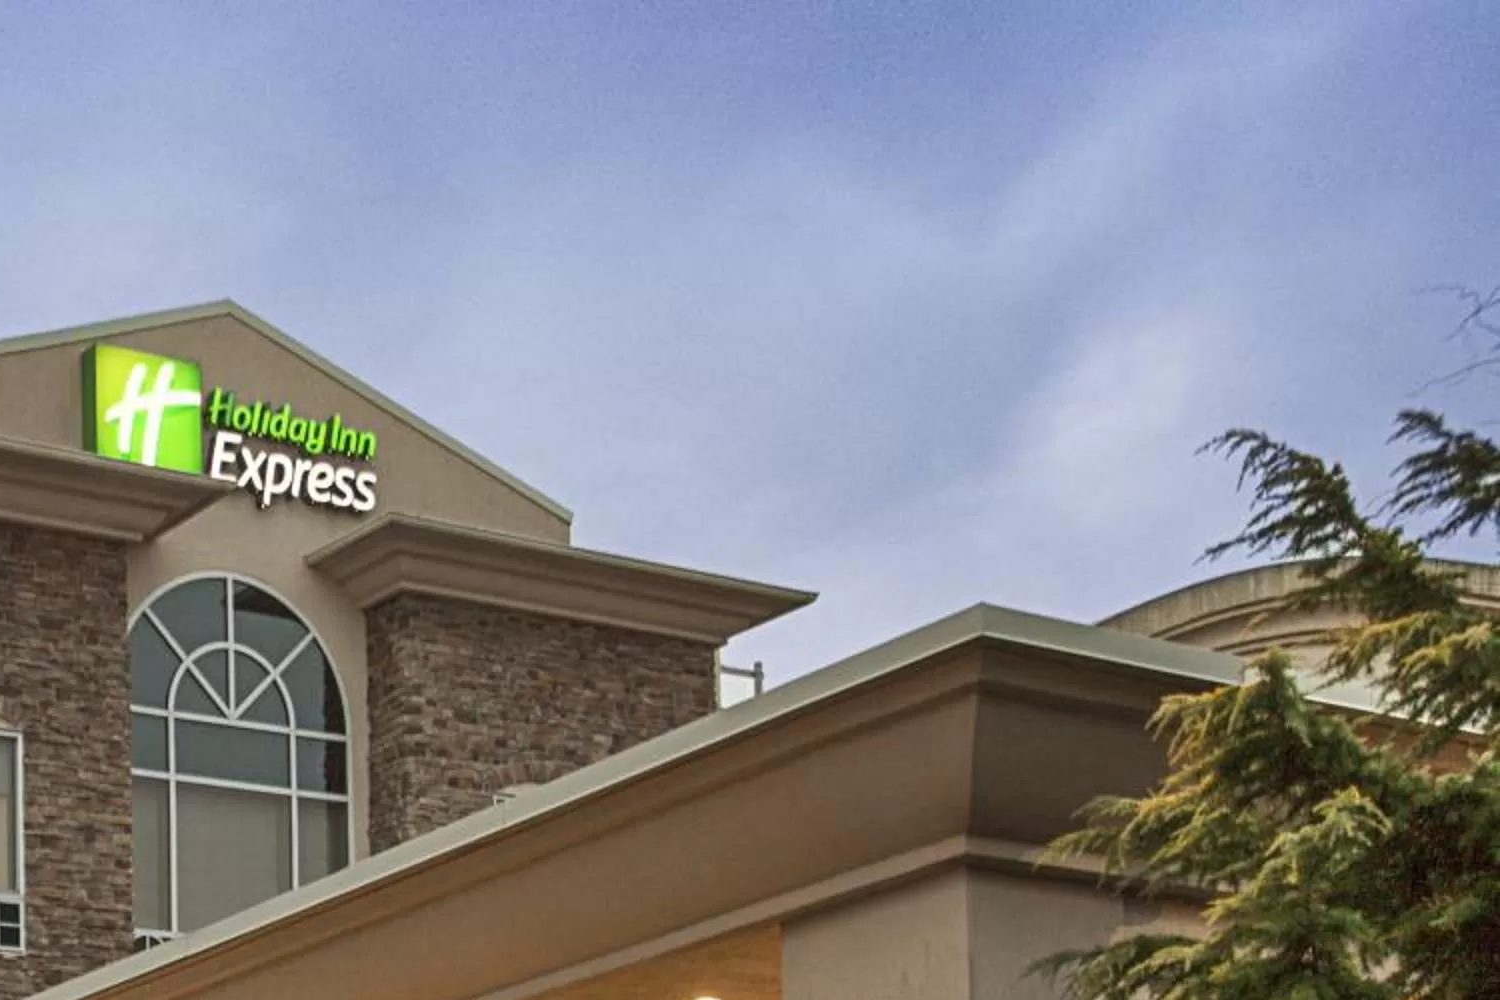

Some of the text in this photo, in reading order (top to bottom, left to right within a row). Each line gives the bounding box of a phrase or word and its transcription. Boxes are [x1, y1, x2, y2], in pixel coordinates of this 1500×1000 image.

[209, 385, 377, 458] Holiday Inn
[210, 430, 378, 512] Express
